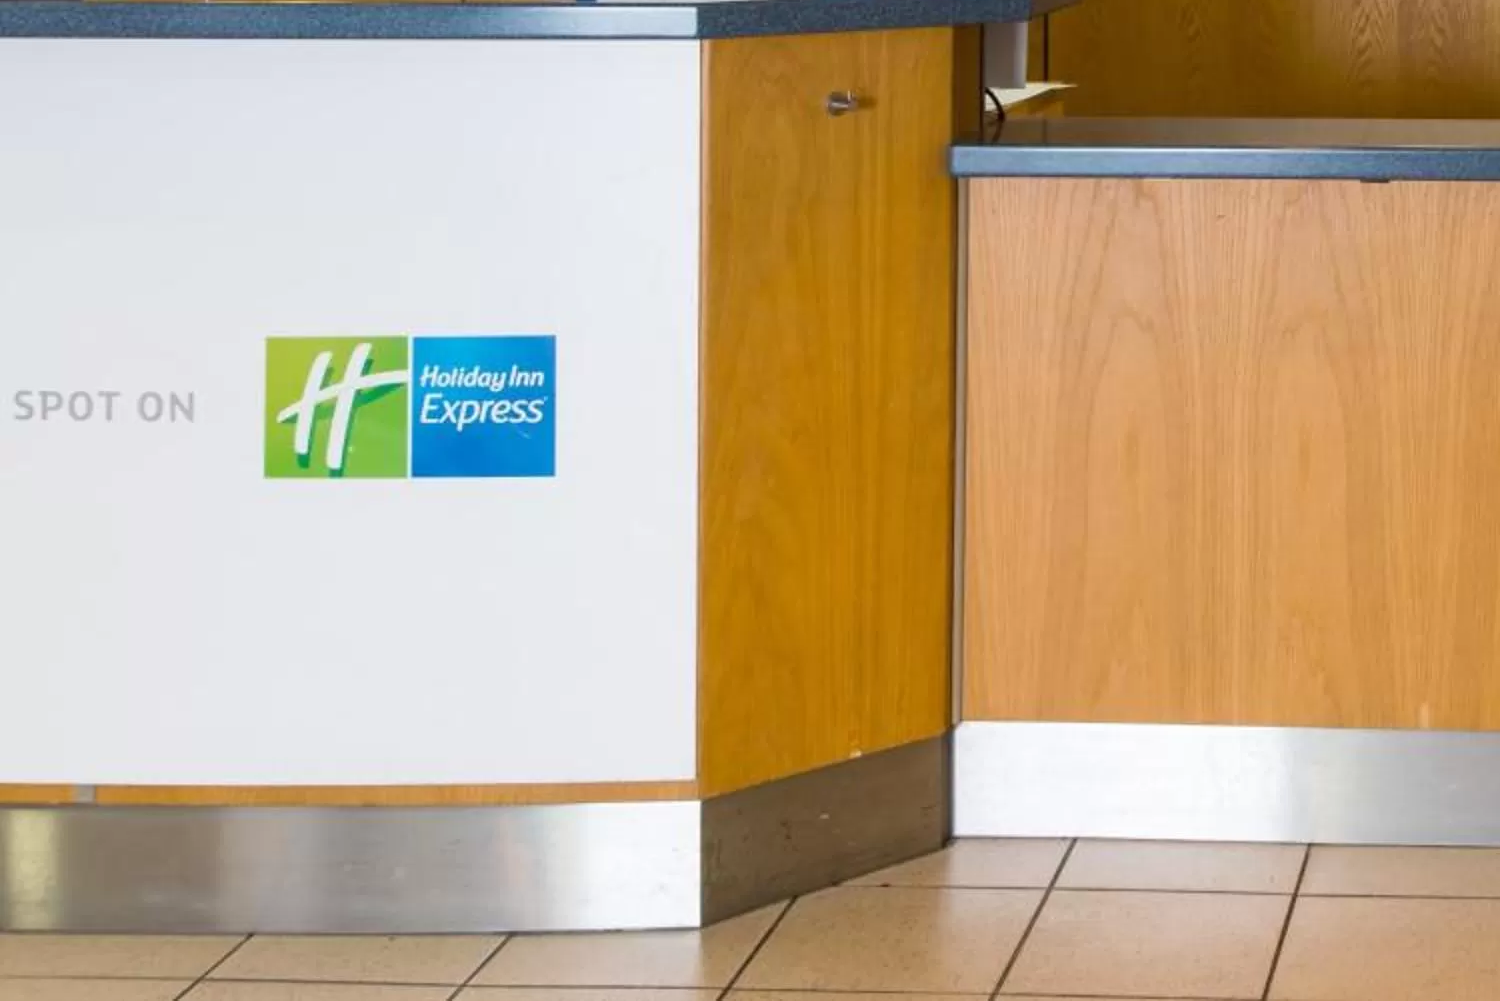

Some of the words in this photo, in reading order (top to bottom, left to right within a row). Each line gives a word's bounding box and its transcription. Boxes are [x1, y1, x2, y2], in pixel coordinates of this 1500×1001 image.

[419, 364, 506, 392] Holiday
[509, 364, 545, 388] Inn
[13, 390, 122, 424] SPOT
[139, 390, 196, 424] ON
[419, 393, 546, 432] Express
